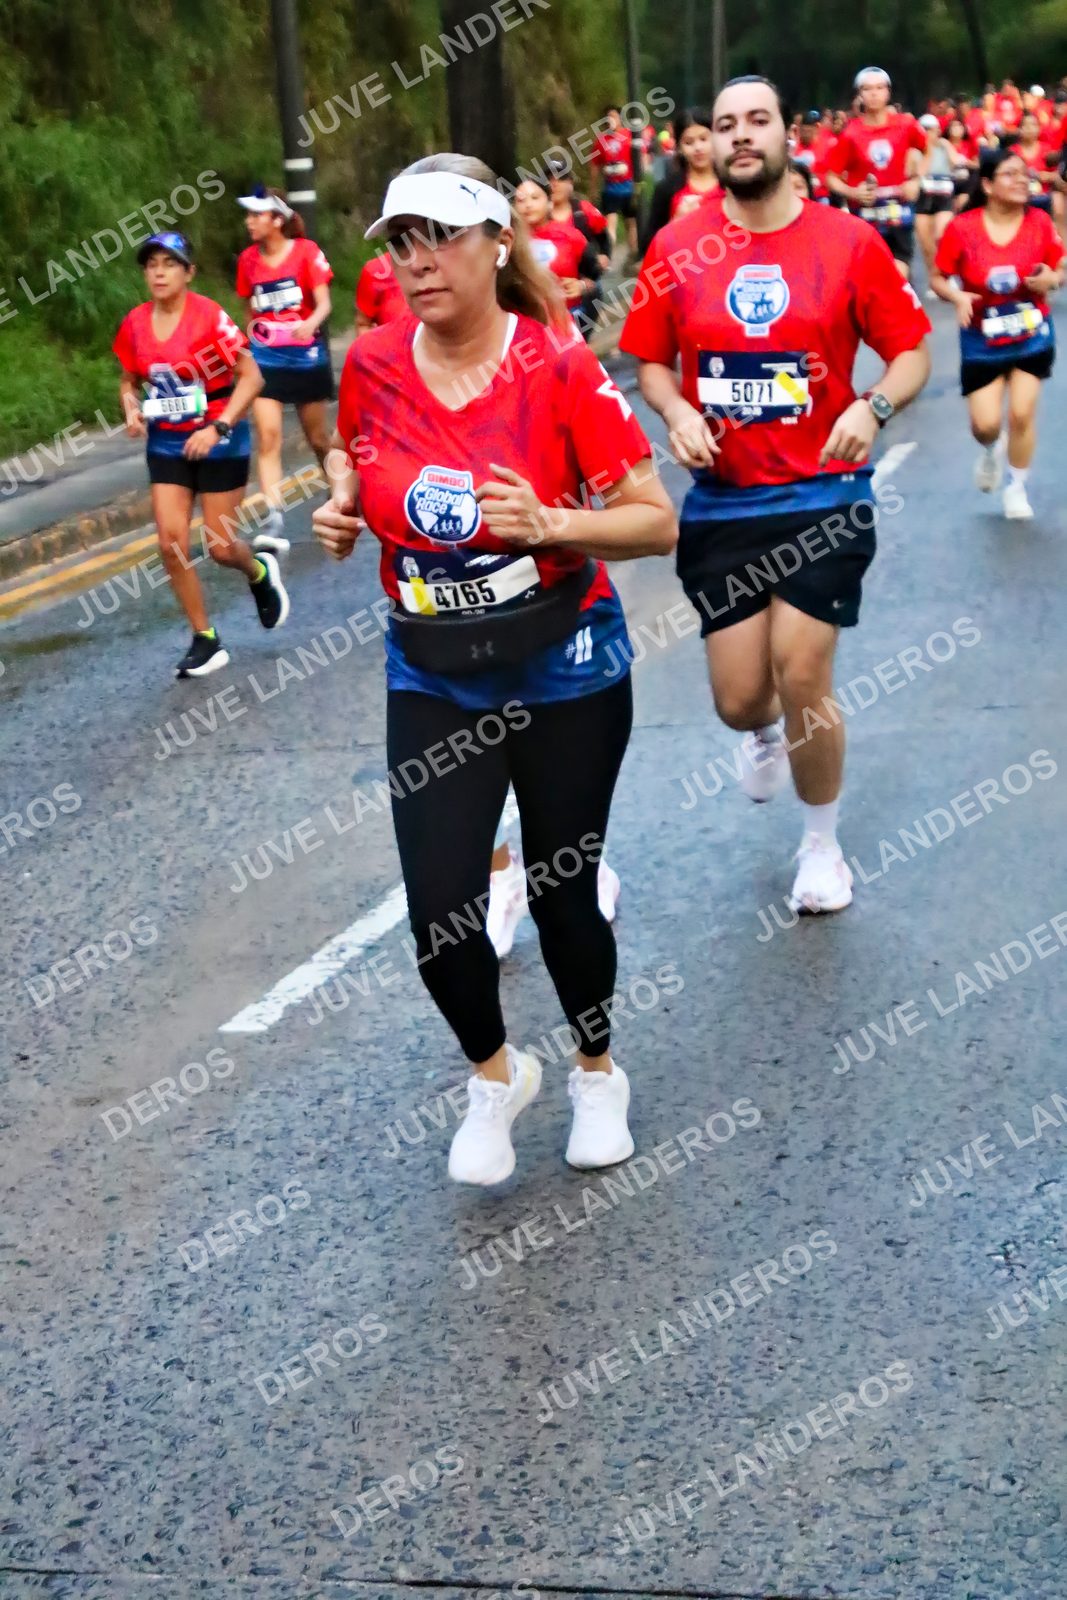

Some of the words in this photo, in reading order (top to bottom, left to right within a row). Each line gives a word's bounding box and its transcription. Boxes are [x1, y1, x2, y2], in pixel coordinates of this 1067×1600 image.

[731, 381, 773, 403] 5071
[427, 473, 465, 488] BIMBO
[415, 497, 448, 515] Race
[424, 486, 464, 507] Global
[434, 578, 497, 608] 4765
